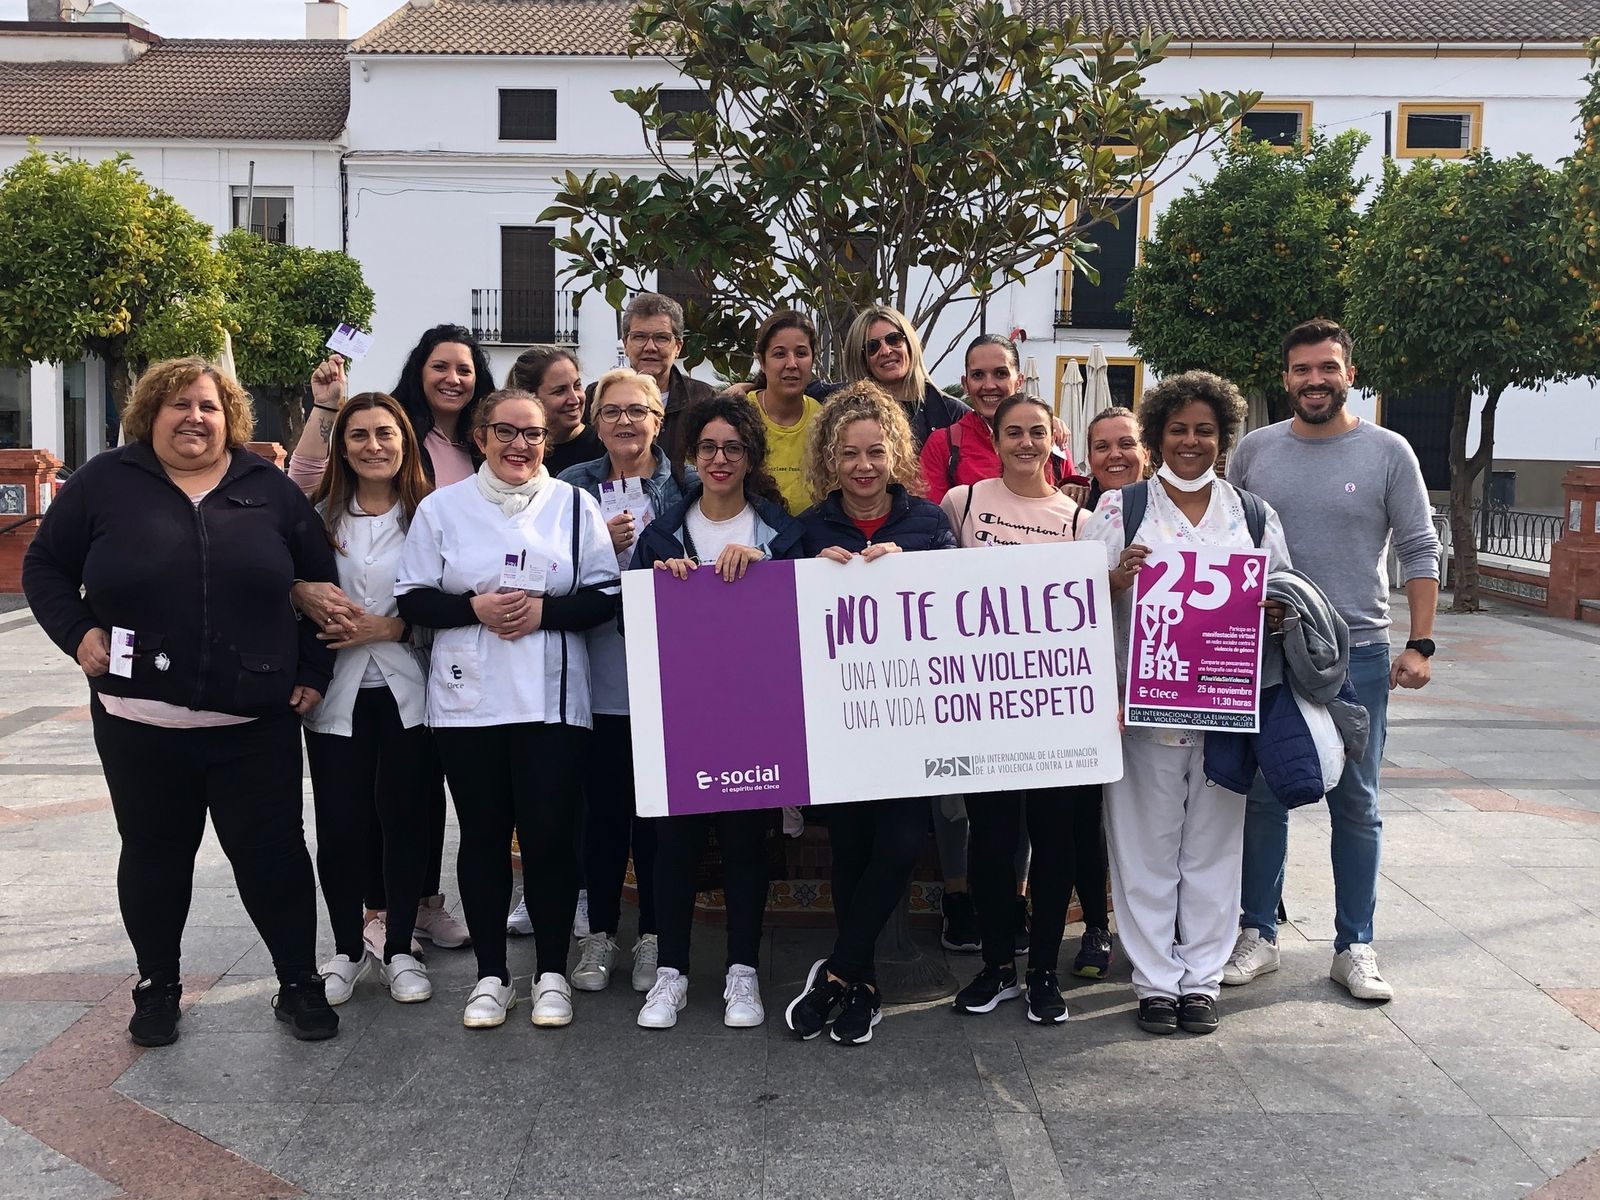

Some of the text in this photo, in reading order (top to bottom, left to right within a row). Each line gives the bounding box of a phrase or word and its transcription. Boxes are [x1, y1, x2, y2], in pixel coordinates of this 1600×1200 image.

[1137, 549, 1232, 611] 25
[825, 578, 1097, 659] ¡NO TE CALLES!
[1140, 604, 1184, 625] NO
[1140, 622, 1169, 643] VI
[1141, 640, 1179, 661] EM
[841, 647, 1092, 691] UNA VIDA SIN VIOLENCIA
[1138, 659, 1190, 682] BRE
[1200, 675, 1250, 683] #UnaVidaSinViolencia
[1150, 688, 1178, 700] Clece
[1197, 684, 1252, 696] 25 de noviembre
[843, 684, 1095, 730] UNA VIDA CON RESPETO
[1212, 696, 1252, 706] 11,30 horas
[1131, 708, 1142, 716] DÍA
[1143, 710, 1192, 719] INTERNACIONAL
[1212, 714, 1253, 722] ELIMINACIÓN
[1155, 716, 1188, 724] VIOLENCIA
[974, 746, 1098, 764] DÍA INTERNACIONAL DE LA ELIMINACIÓN
[720, 764, 780, 785] social
[924, 756, 972, 778] 25N
[976, 758, 1099, 775] DE LA VIOLENCIA CONTRA LA MUJER
